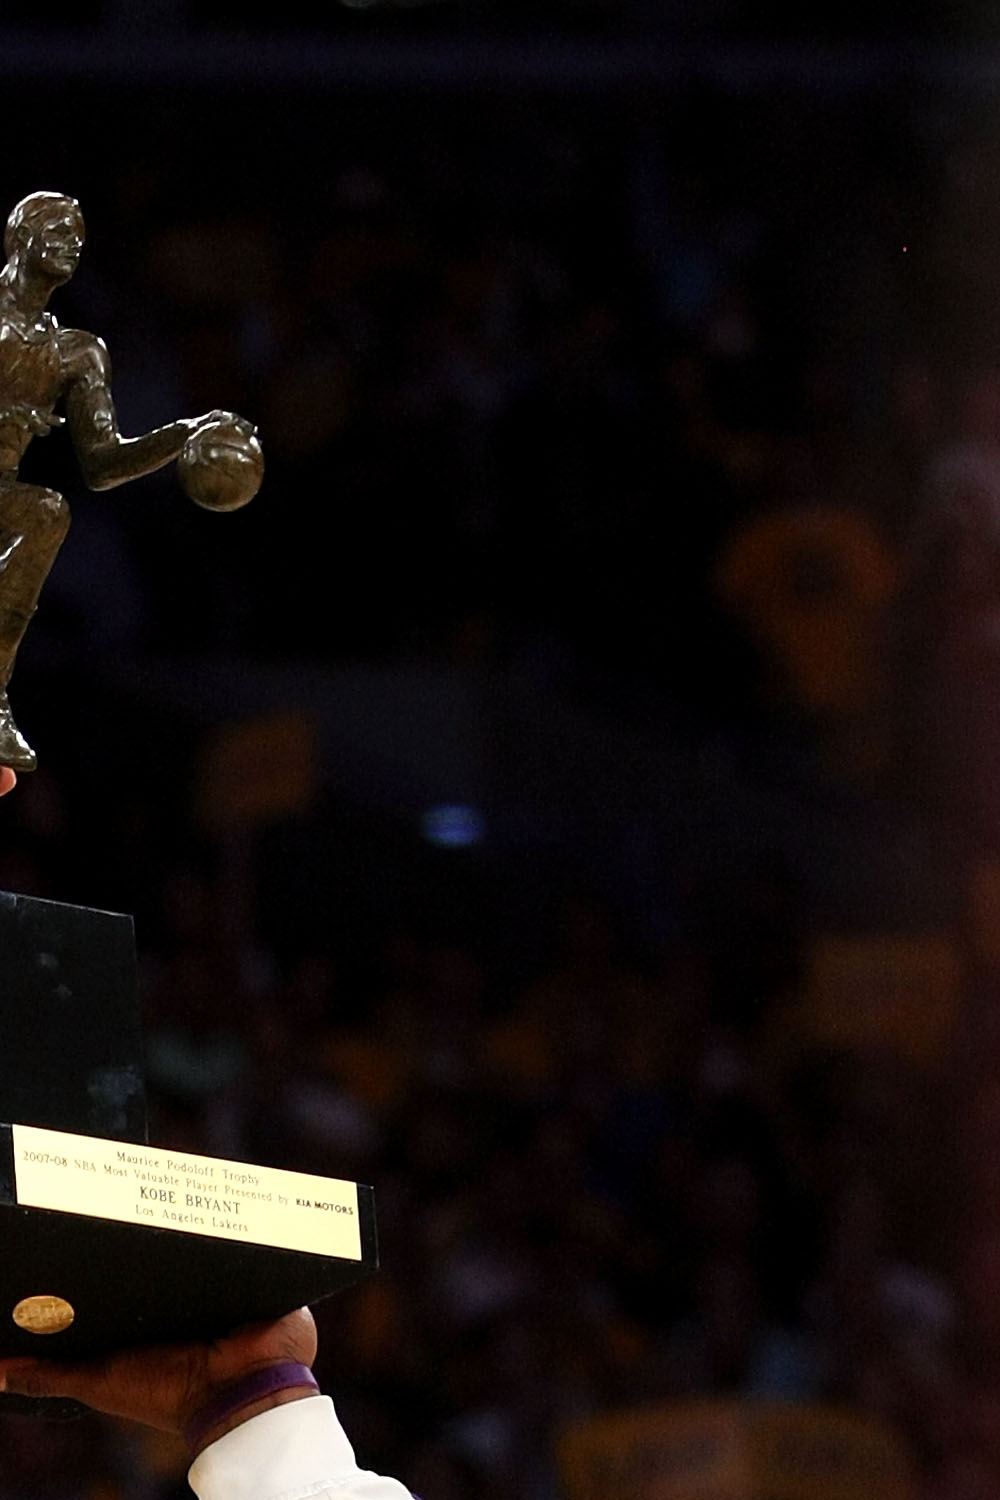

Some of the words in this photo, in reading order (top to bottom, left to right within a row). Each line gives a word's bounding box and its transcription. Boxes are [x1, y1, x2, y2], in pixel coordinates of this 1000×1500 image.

[23, 1150, 68, 1167] 2007-08
[74, 1159, 97, 1172] NBA
[103, 1163, 128, 1178] Most
[134, 1169, 179, 1186] Valuable
[186, 1177, 217, 1193] Player
[225, 1184, 272, 1202] Presented
[278, 1194, 289, 1206] by
[295, 1198, 311, 1208] KIA
[314, 1202, 354, 1216] MOTORS
[117, 1151, 159, 1168] Maurice
[222, 1168, 260, 1186] Trophy
[139, 1185, 177, 1204] KOBE
[185, 1193, 240, 1215] BRYANT
[135, 1204, 154, 1217] Los
[162, 1208, 205, 1225] Angeles
[212, 1216, 249, 1232] Lakers
